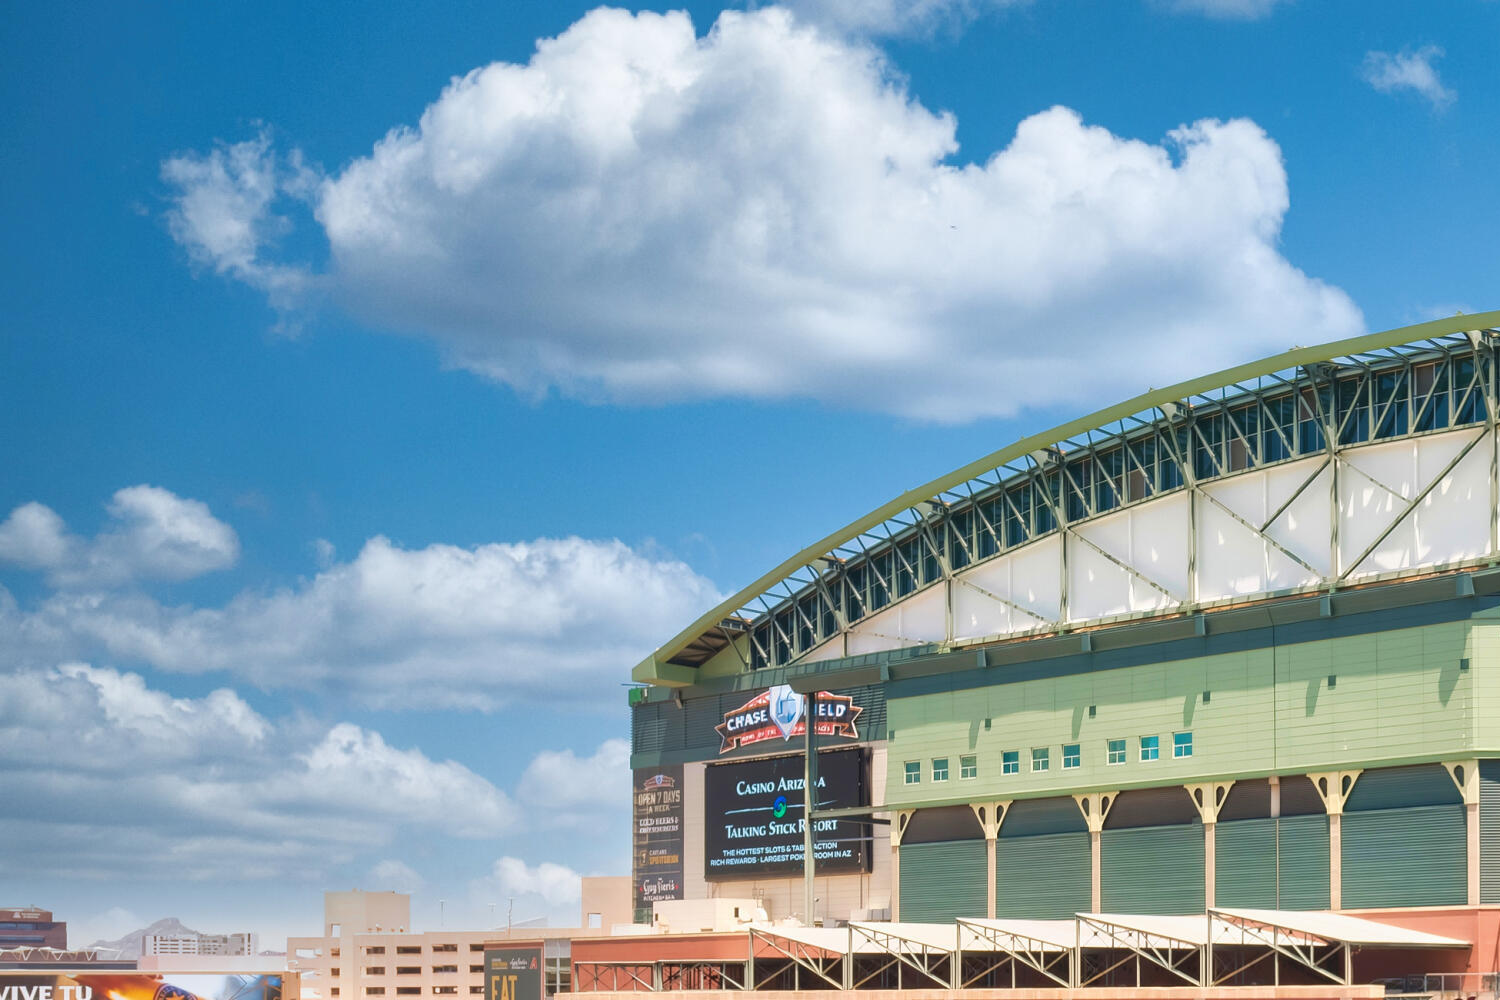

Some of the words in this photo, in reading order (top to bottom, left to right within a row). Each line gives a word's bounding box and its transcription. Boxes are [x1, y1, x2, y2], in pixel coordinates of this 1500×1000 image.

[727, 710, 768, 731] CHASE
[804, 703, 846, 718] ELD
[638, 792, 656, 806] OPEN
[663, 790, 680, 803] DAYS
[723, 849, 735, 857] THE
[736, 847, 764, 856] HOTTEST
[765, 846, 785, 854] SLOTS
[814, 842, 837, 850] ACTION
[710, 858, 725, 866] RICH
[725, 857, 757, 865] REWARDS
[760, 854, 789, 863] LARGEST
[814, 851, 833, 859] ROOM
[643, 879, 657, 895] Guy
